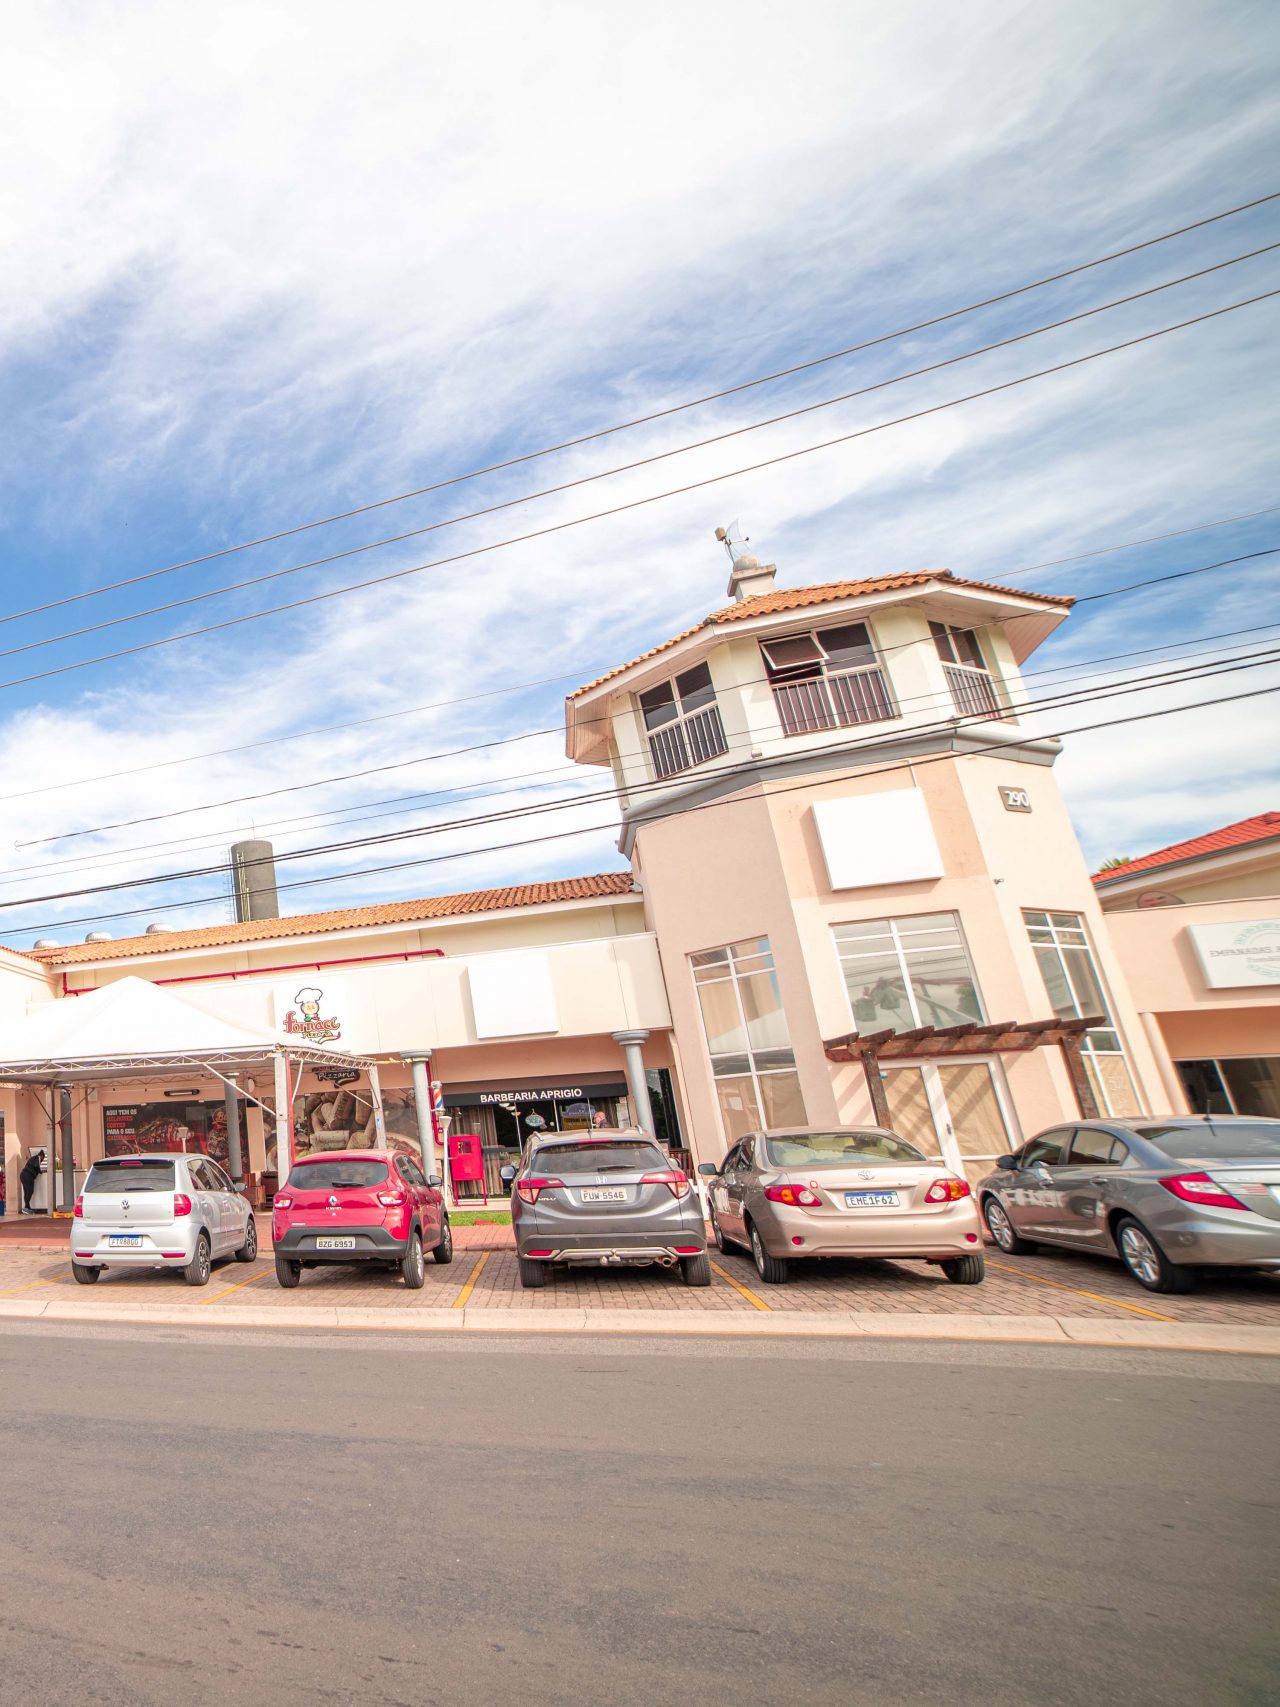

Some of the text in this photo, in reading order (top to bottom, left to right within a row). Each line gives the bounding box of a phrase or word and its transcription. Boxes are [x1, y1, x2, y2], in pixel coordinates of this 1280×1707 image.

[1004, 791, 1030, 807] 290
[480, 1088, 583, 1103] BARBEARIA APRIGIO
[850, 1196, 894, 1205] EME1F62
